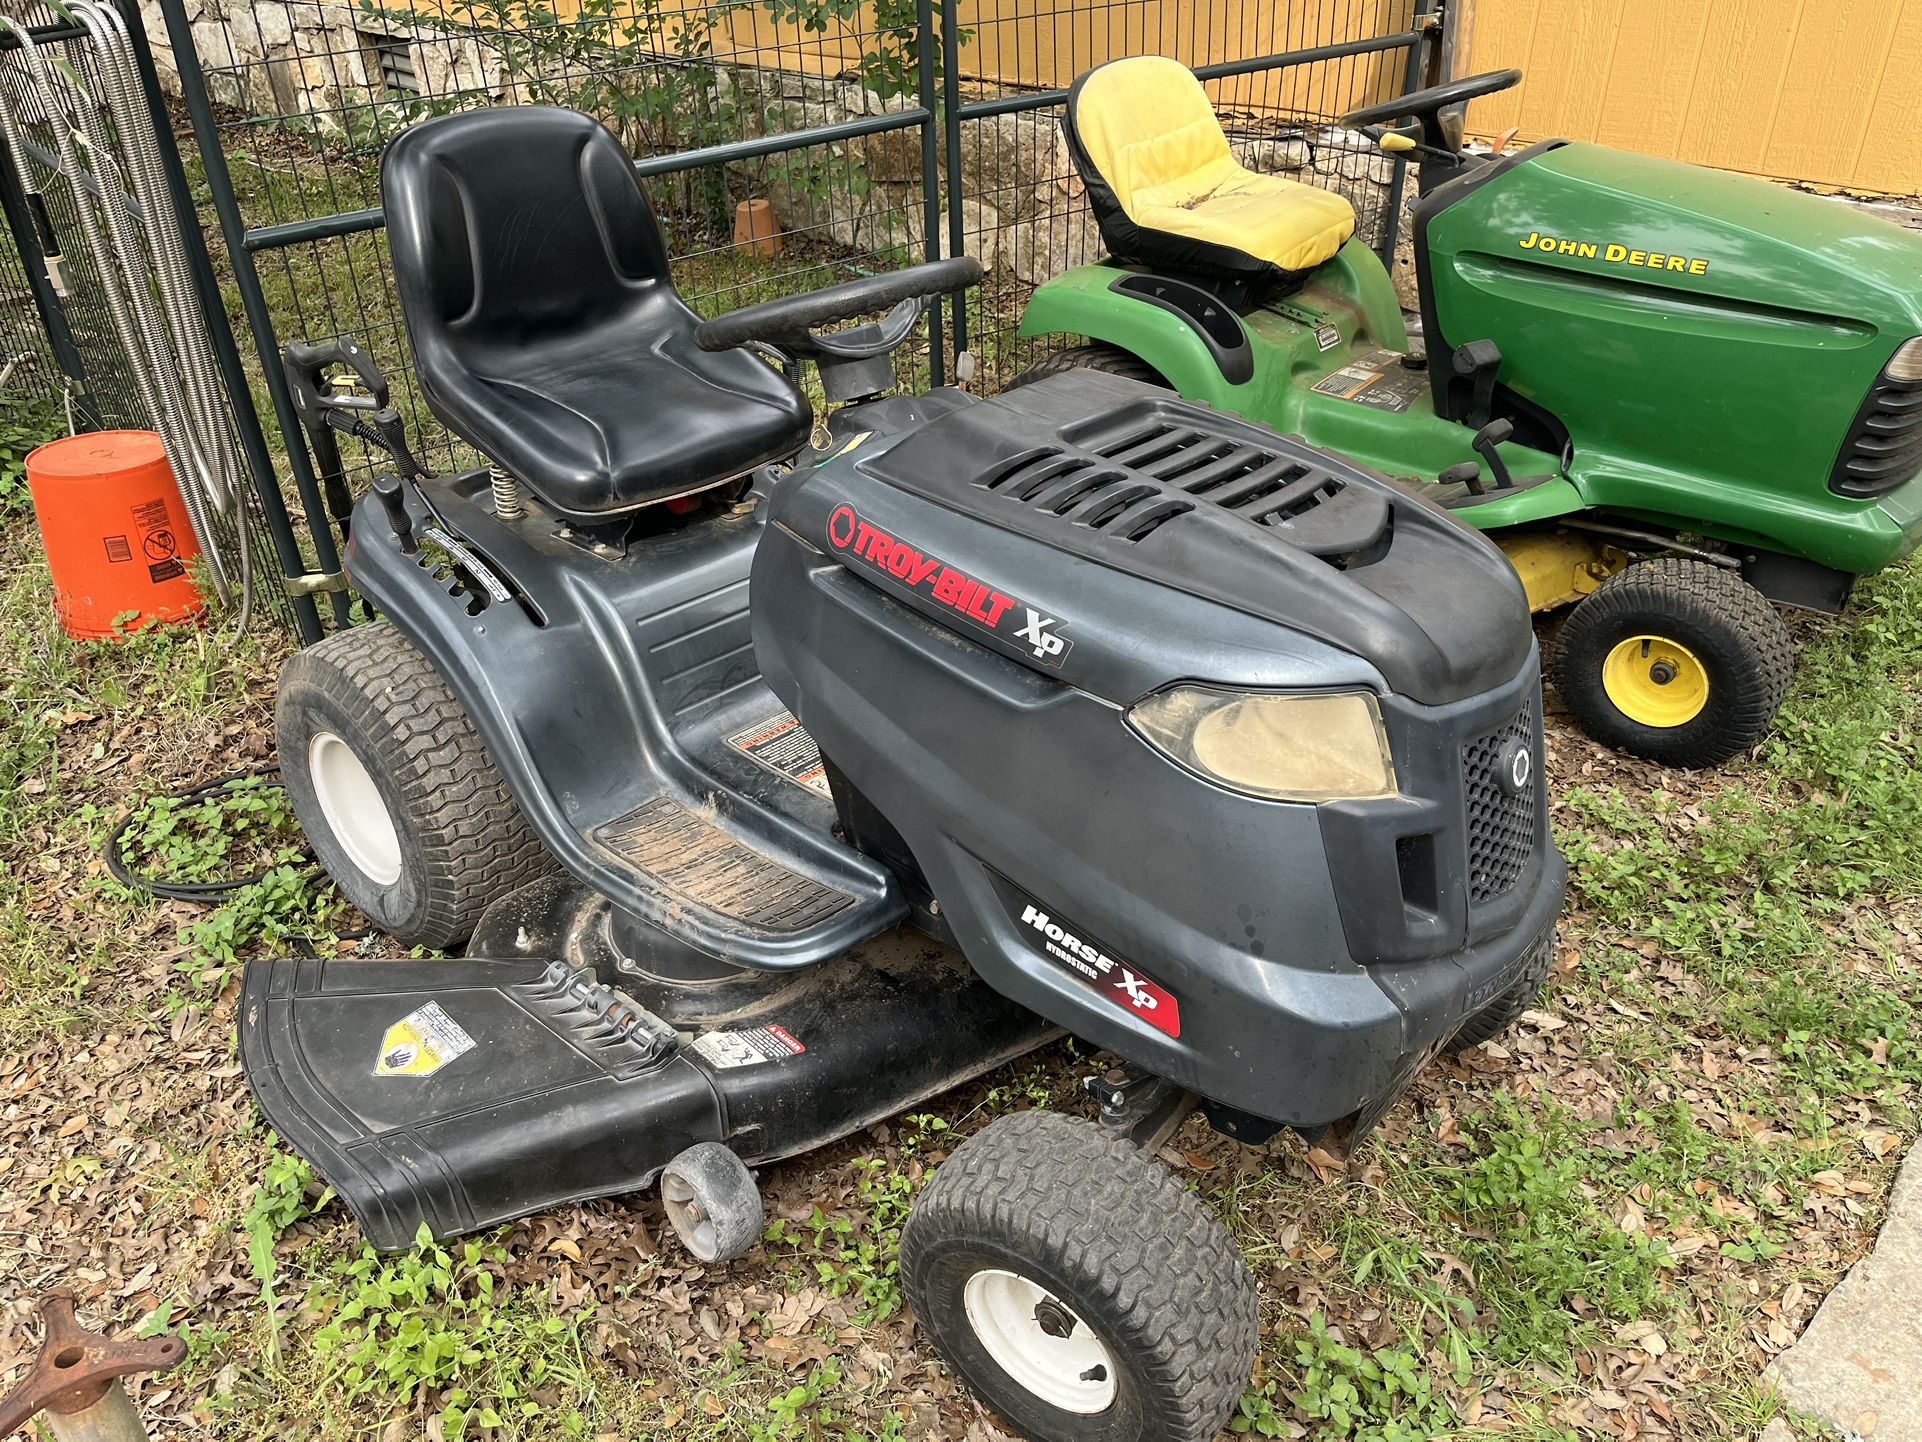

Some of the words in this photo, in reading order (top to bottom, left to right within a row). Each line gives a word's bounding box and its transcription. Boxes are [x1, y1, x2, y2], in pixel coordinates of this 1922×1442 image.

[1519, 232, 1598, 259] JOHN
[1604, 243, 1709, 276] DEERE
[853, 521, 1015, 629] TROY-BILT
[1021, 904, 1115, 974] HORSE
[1045, 941, 1098, 980] HYDROSTATIC
[775, 1030, 801, 1051] DANGER
